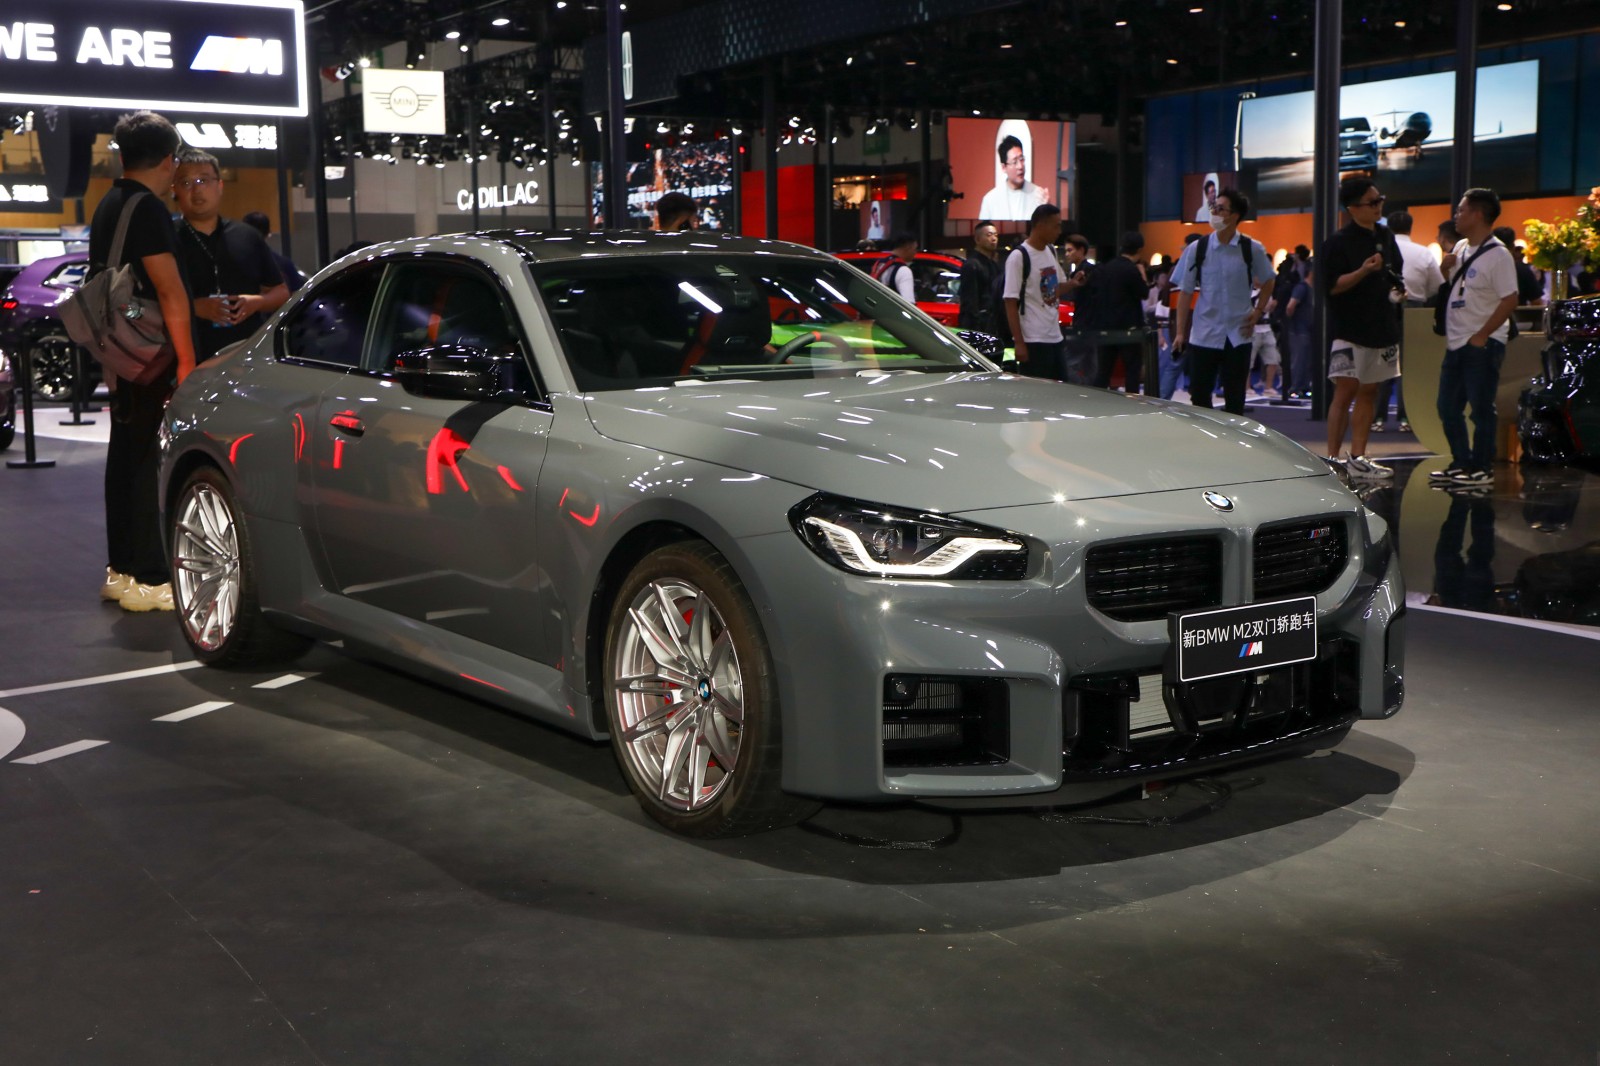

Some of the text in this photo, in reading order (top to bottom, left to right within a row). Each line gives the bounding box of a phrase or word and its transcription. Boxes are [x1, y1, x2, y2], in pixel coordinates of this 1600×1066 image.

[76, 27, 173, 68] ARE
[393, 97, 416, 107] MINI
[1182, 611, 1314, 649] 新BMW M2双门轿跑车
